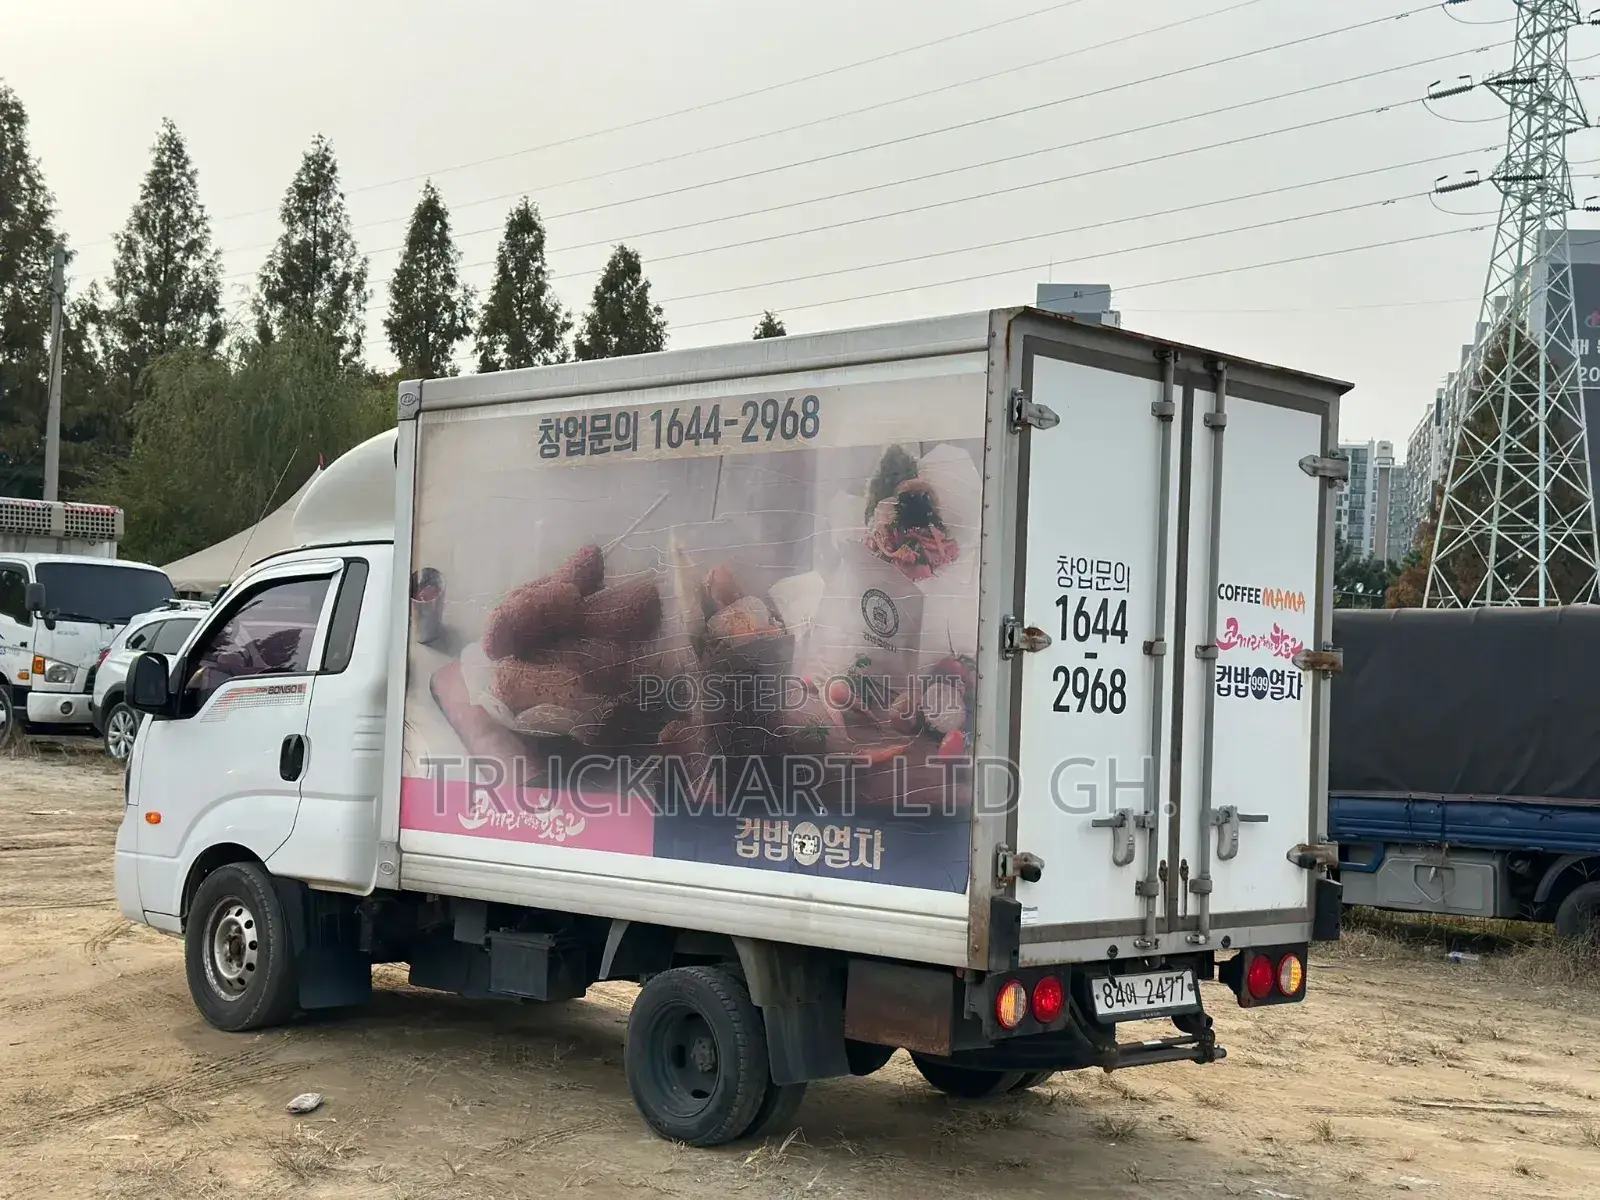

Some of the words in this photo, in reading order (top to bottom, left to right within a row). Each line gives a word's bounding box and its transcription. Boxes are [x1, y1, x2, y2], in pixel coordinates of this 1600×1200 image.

[538, 411, 639, 459] 창업문의
[650, 394, 820, 450] 1644-2968
[1055, 594, 1129, 644] 1644
[1217, 583, 1262, 604] COFFEE
[1262, 587, 1306, 614] MAMA
[1052, 665, 1127, 714] 2968
[734, 816, 791, 862] 컵밥
[822, 824, 885, 870] 열차
[1144, 975, 1184, 1005] 2477
